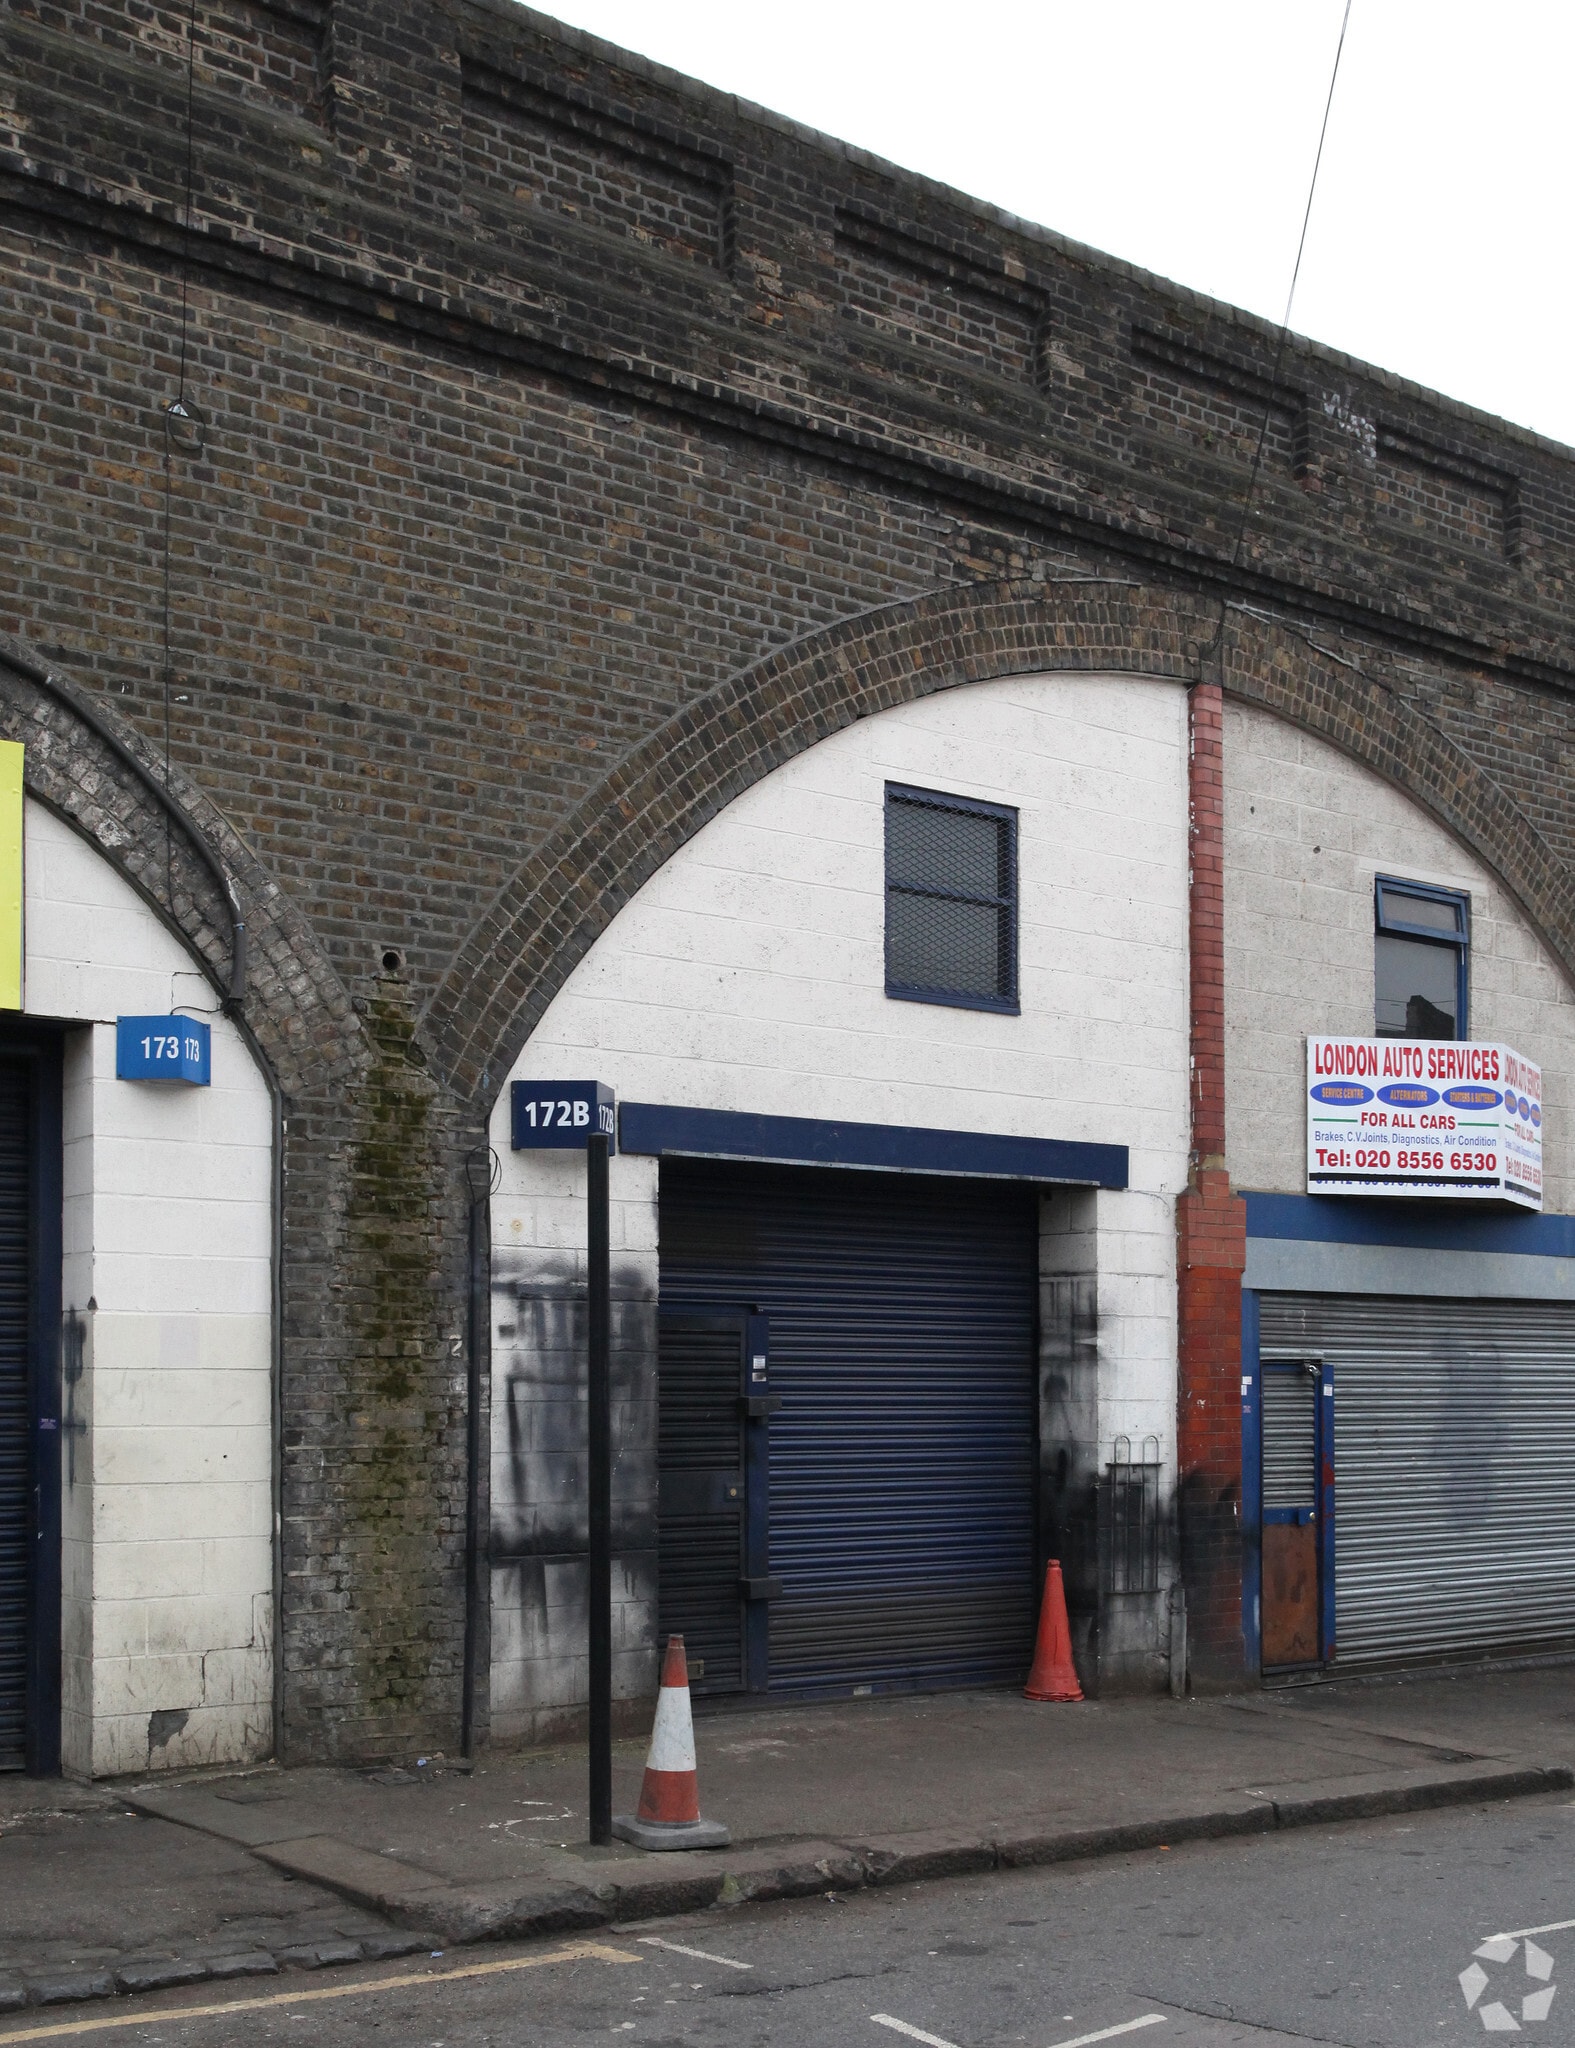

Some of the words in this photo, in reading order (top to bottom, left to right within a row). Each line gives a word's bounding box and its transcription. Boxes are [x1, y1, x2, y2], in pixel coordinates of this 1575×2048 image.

[141, 1036, 179, 1059] 173
[184, 1037, 200, 1062] 173
[1315, 1043, 1378, 1076] LONDON
[1383, 1046, 1423, 1079] AUTO
[1428, 1047, 1500, 1081] SERVICES
[1321, 1087, 1343, 1099] SERVICE
[1344, 1087, 1365, 1100] CENTRE
[1390, 1089, 1428, 1102] ALTERNATORS
[525, 1101, 590, 1127] 172B
[599, 1104, 614, 1134] 172B
[1361, 1112, 1387, 1127] FOR
[1391, 1113, 1416, 1128] ALL
[1420, 1114, 1456, 1130] CARS
[1315, 1131, 1346, 1143] Brakes,
[1392, 1133, 1442, 1147] Diagnostics,
[1444, 1135, 1456, 1145] Air
[1458, 1135, 1497, 1147] Condition
[1315, 1148, 1351, 1167] Tel:
[1355, 1149, 1391, 1168] 020
[1397, 1150, 1444, 1169] 8556
[1450, 1152, 1497, 1171] 6530
